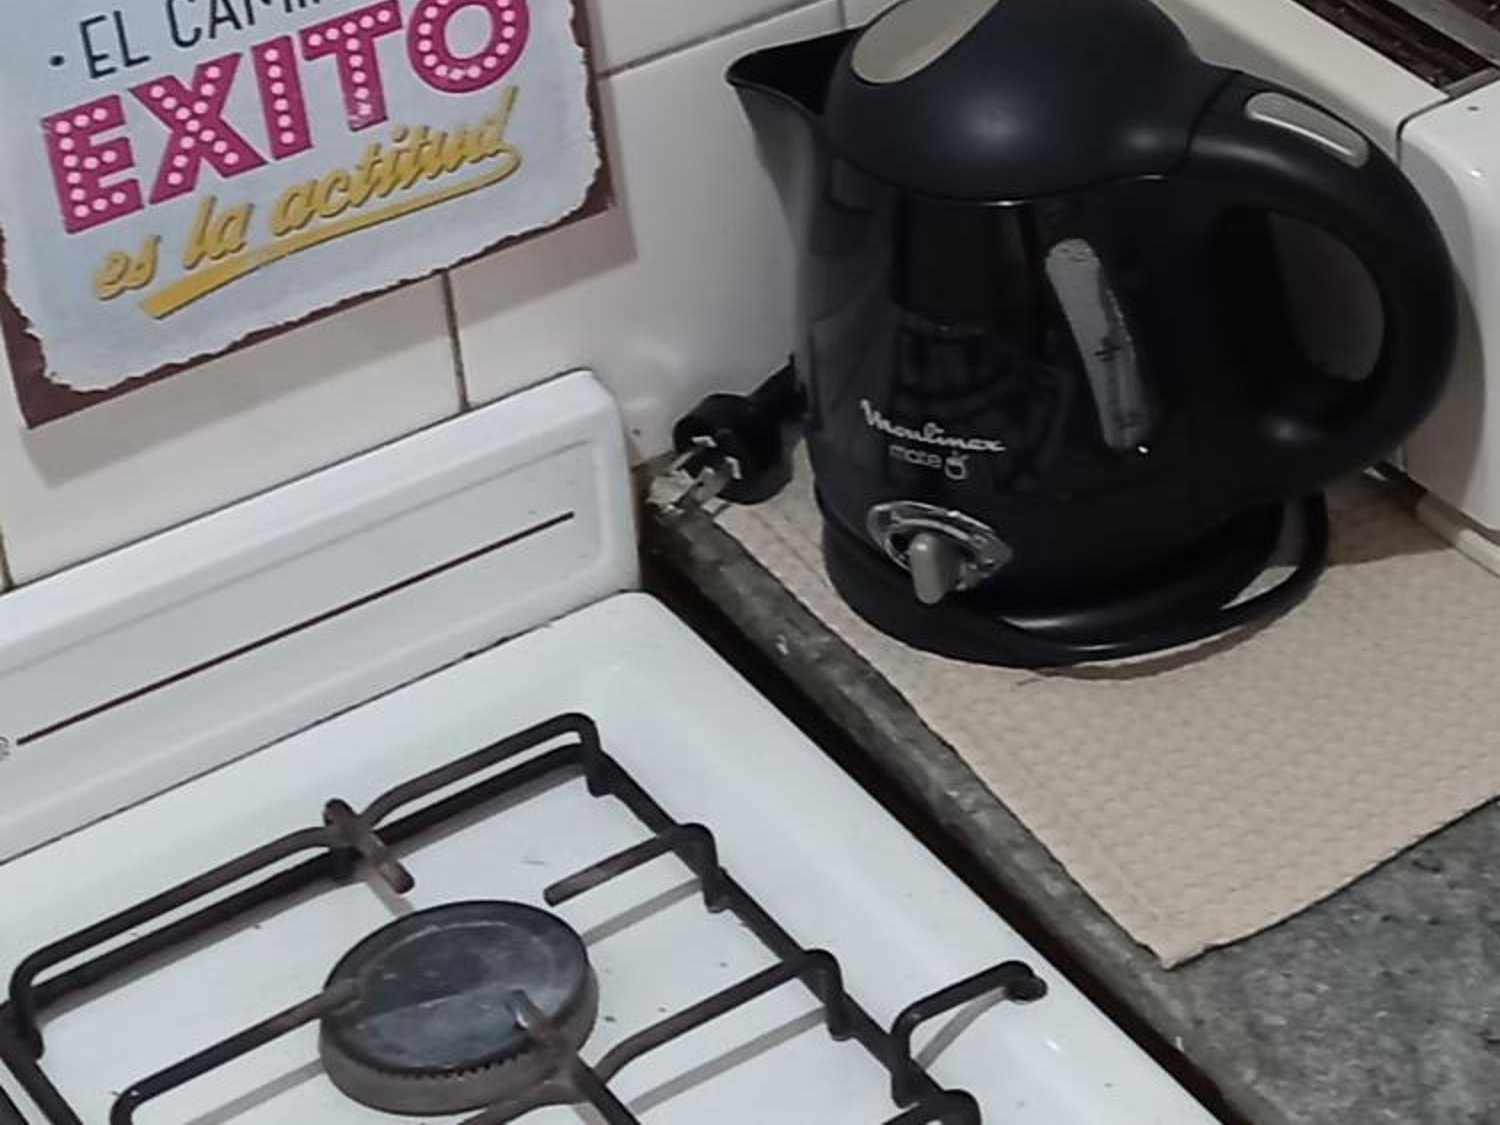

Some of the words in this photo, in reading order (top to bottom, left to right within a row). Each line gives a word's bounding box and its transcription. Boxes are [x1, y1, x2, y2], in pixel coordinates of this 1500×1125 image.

[80, 11, 150, 77] EL
[93, 234, 162, 300] es
[184, 196, 254, 269] la
[269, 86, 519, 236] actitud
